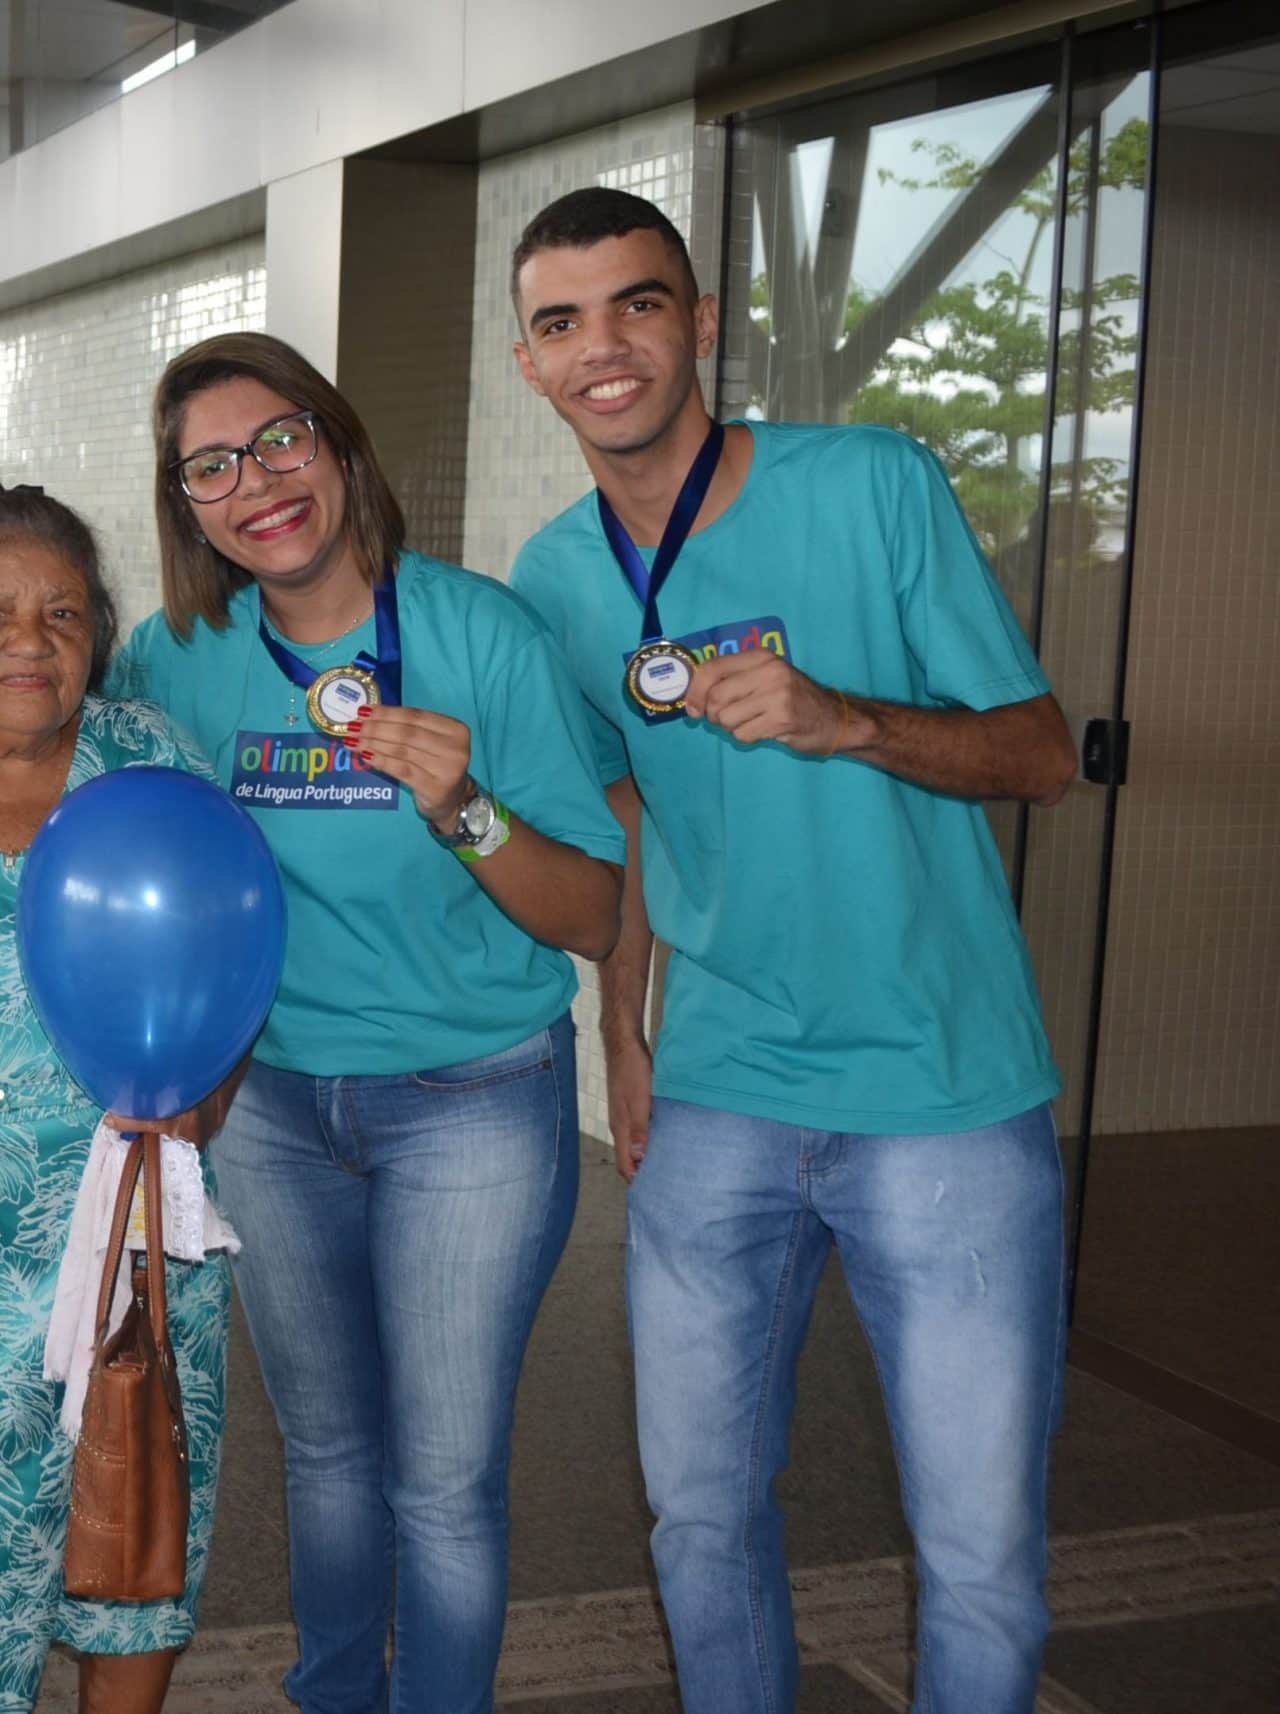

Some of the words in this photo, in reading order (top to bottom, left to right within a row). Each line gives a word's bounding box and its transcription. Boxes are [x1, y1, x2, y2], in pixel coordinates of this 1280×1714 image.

[235, 782, 252, 797] de
[254, 783, 302, 804] Língua
[304, 785, 392, 805] Portuguesa
